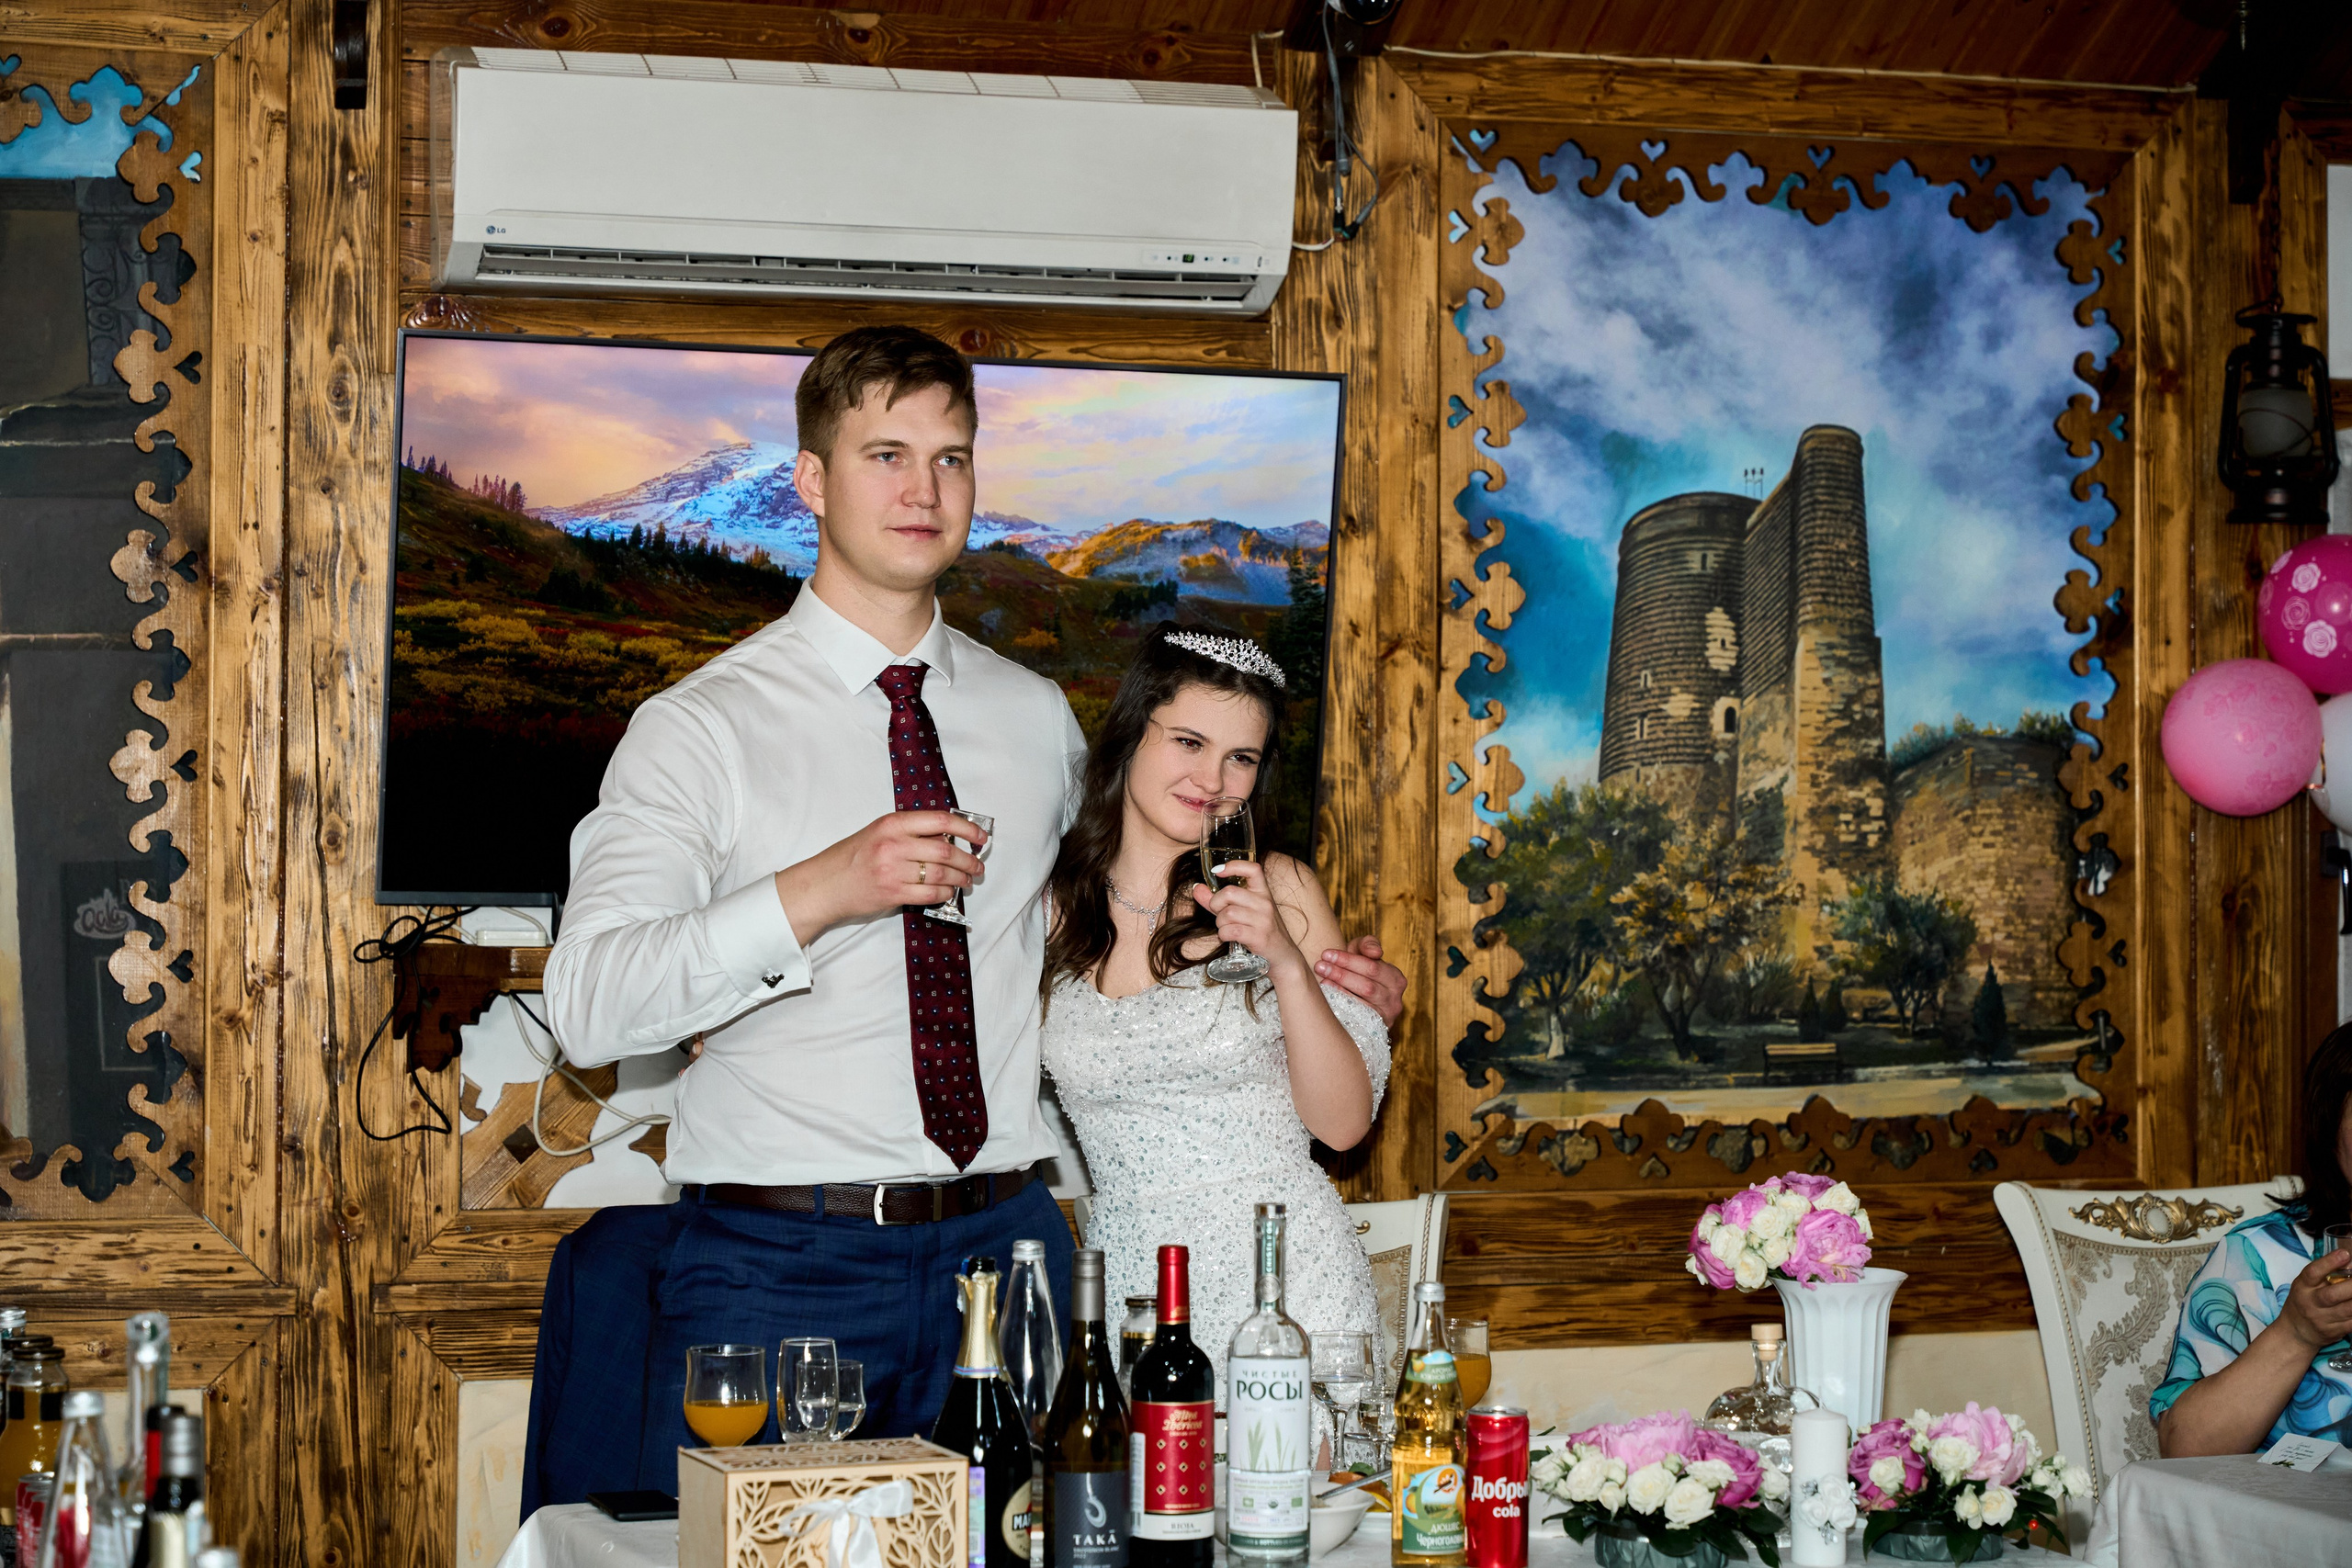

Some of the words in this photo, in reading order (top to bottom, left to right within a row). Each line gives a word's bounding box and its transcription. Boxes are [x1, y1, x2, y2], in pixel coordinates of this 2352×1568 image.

[1242, 1370, 1297, 1379] ЧИСТЫЕ
[1237, 1380, 1303, 1401] РОСЫ
[1492, 1503, 1521, 1518] cola
